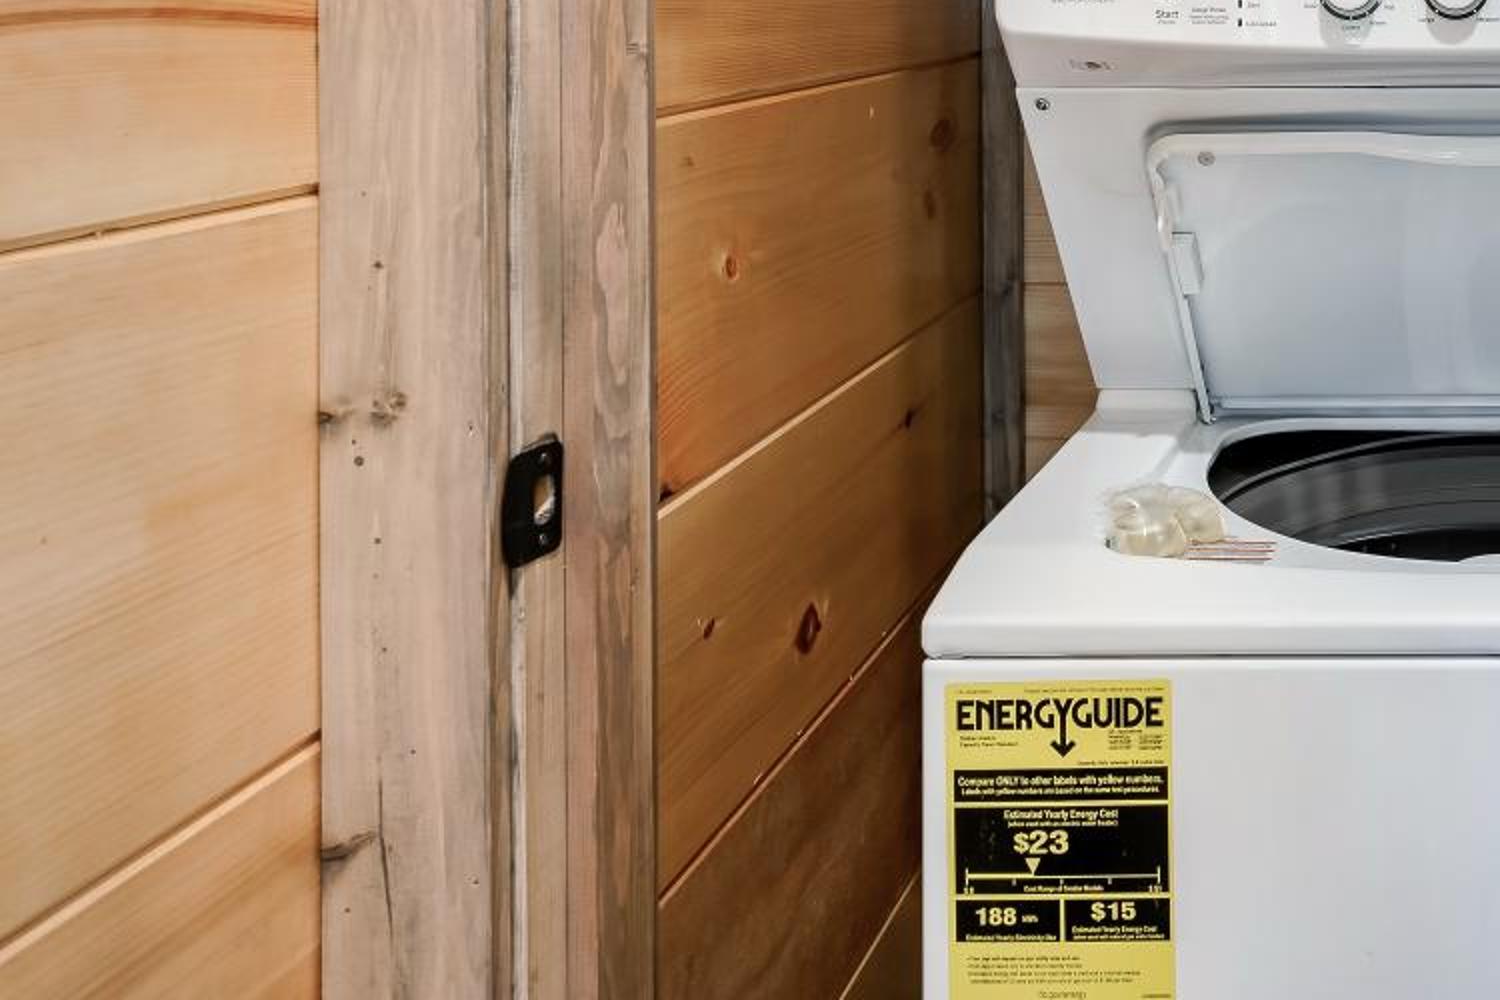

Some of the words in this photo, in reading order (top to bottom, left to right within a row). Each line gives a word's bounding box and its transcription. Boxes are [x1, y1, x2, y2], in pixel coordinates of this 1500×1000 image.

[1155, 8, 1180, 19] Start
[956, 695, 1164, 733] ENERGYGUIDE
[957, 775, 995, 788] Compare
[1053, 774, 1078, 786] labels
[1079, 774, 1097, 785] with
[1097, 773, 1125, 787] yellow
[1003, 809, 1042, 819] Estimated
[1043, 809, 1069, 822] Yearly
[1069, 808, 1098, 821] Energy
[1099, 808, 1119, 819] Cost
[1012, 829, 1070, 856] $23
[975, 907, 1017, 927] 188
[1090, 901, 1138, 922] $15
